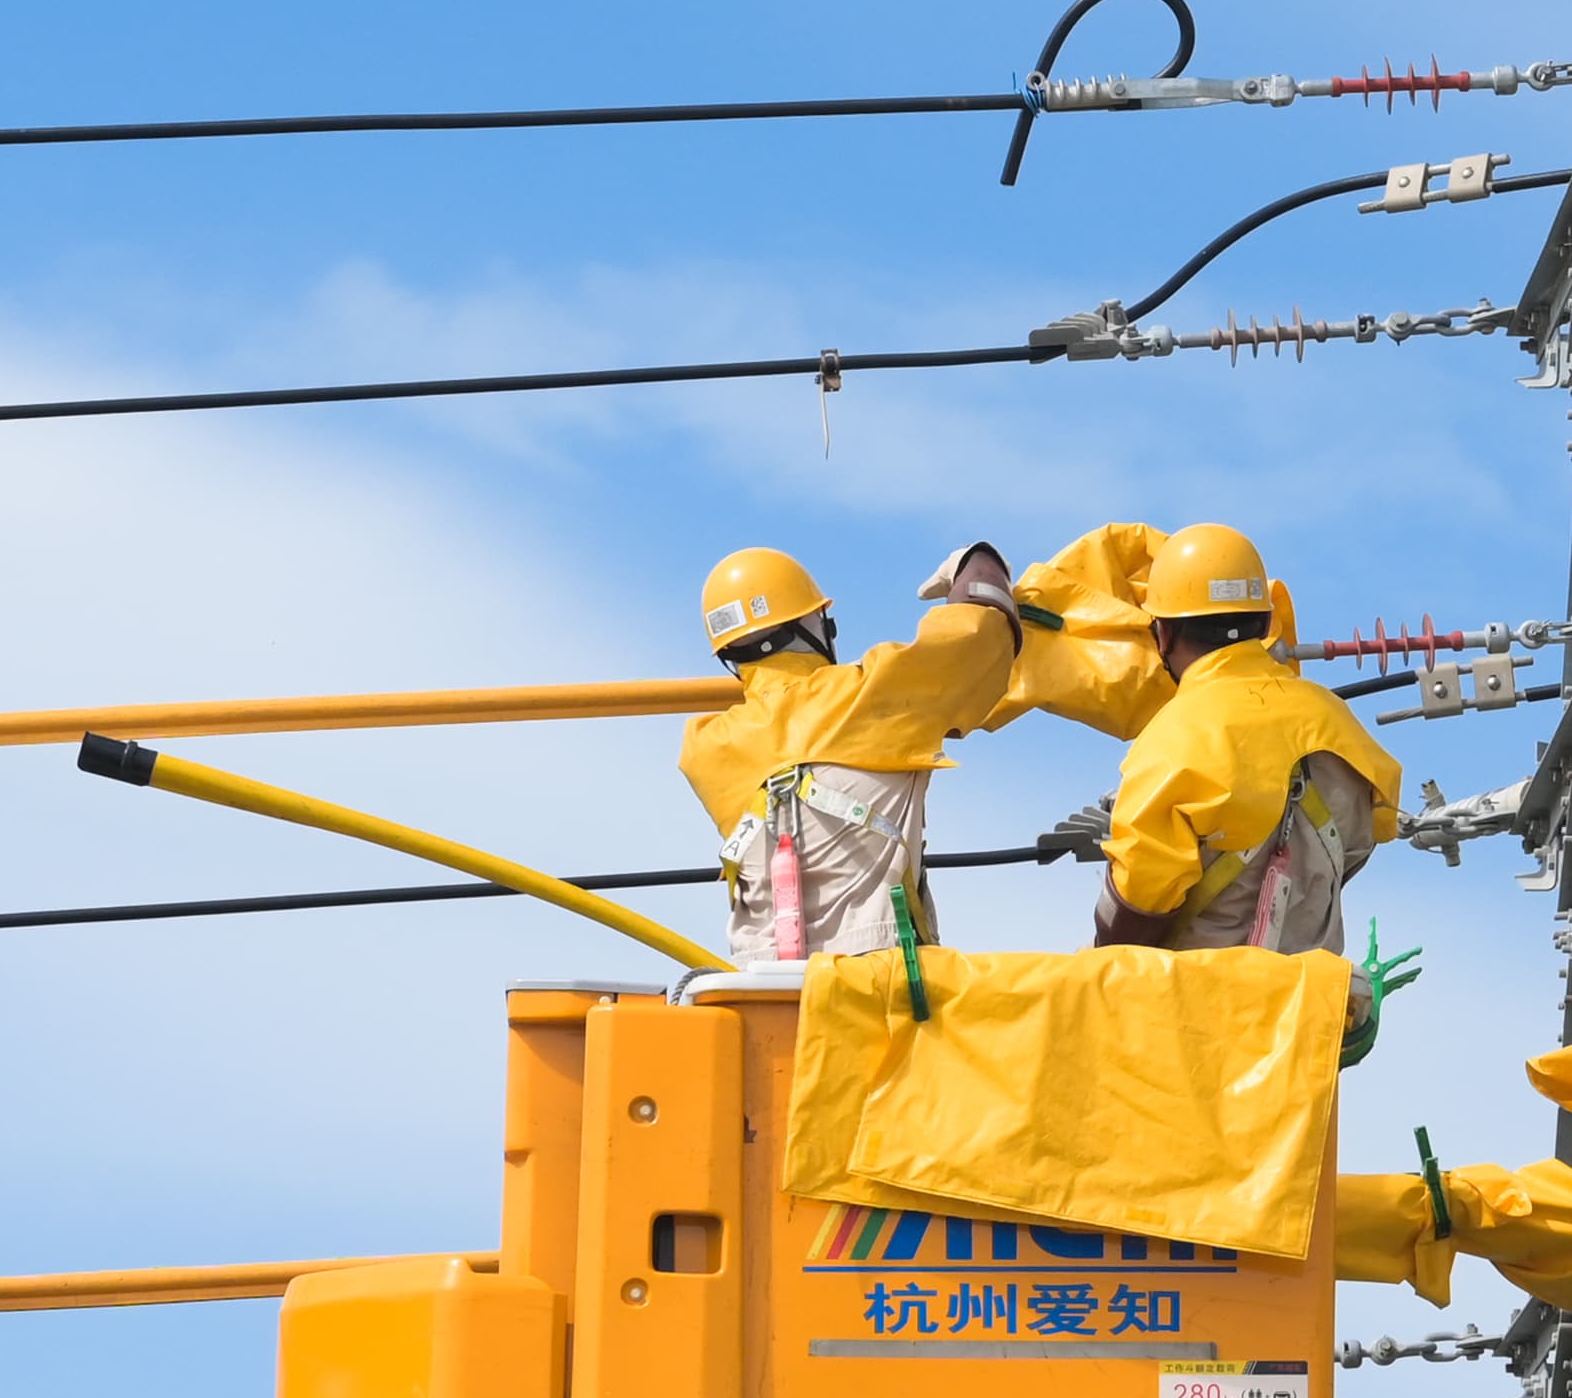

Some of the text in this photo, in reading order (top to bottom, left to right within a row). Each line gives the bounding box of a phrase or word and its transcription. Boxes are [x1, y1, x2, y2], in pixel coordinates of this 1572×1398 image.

[724, 840, 740, 857] A
[863, 1281, 1181, 1336] 杭州爱知
